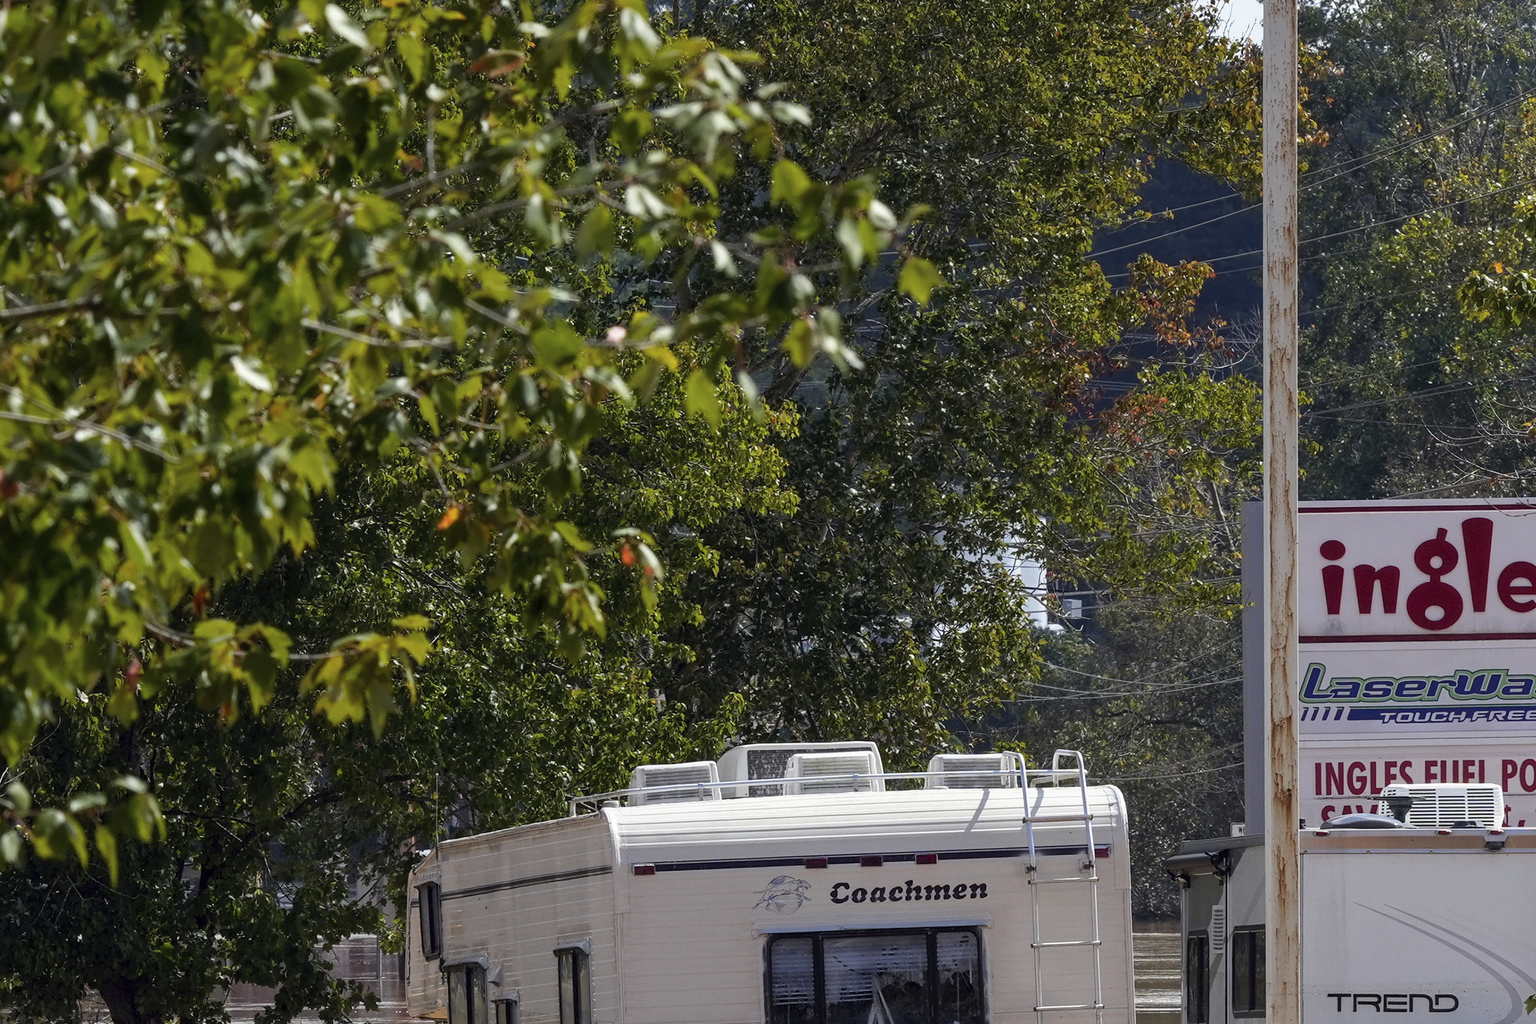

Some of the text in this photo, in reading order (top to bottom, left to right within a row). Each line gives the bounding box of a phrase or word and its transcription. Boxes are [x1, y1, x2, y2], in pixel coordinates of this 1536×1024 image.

[1314, 760, 1414, 796] INGLES
[829, 880, 989, 905] Coachmen
[1327, 993, 1460, 1013] TREND
